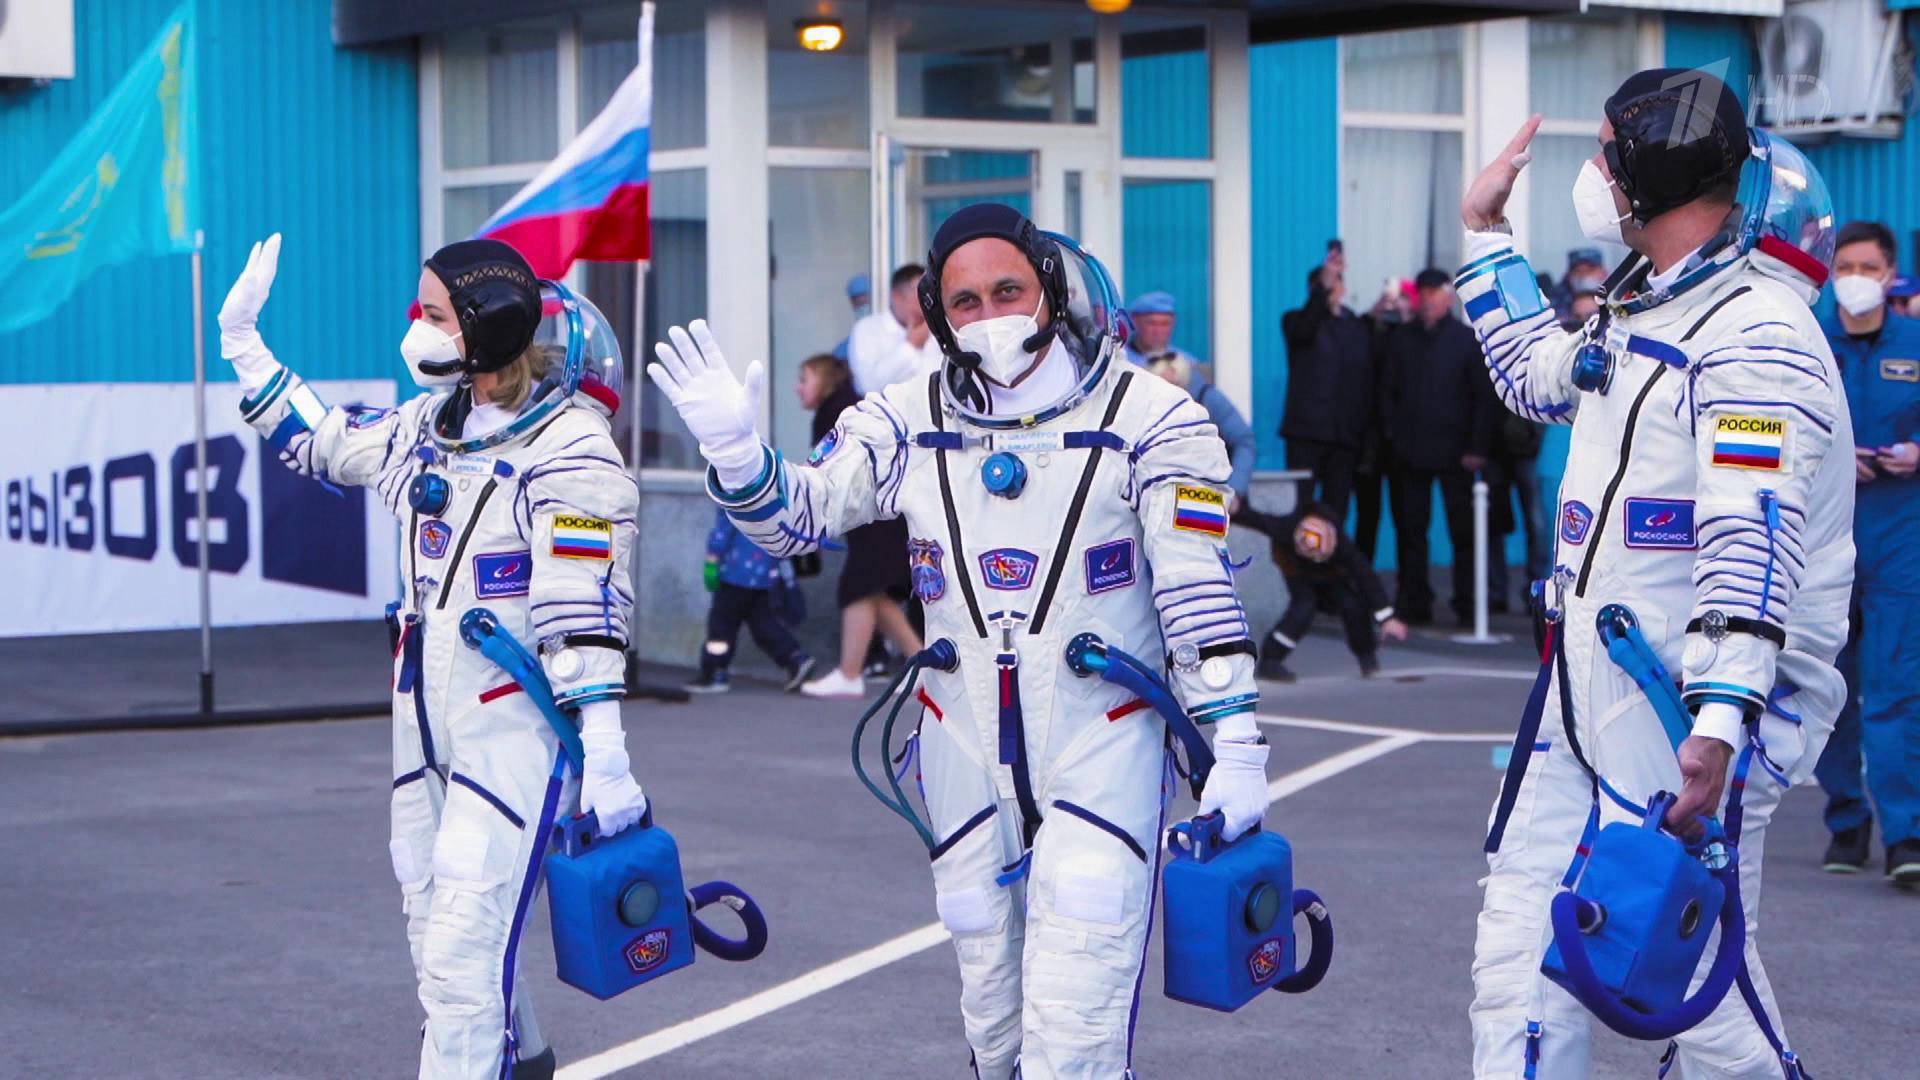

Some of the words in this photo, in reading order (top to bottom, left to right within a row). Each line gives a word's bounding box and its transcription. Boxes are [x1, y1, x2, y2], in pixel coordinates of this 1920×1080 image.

[1717, 418, 1782, 434] РОССИЯ
[8, 434, 250, 575] ВЫЗОВ
[555, 516, 609, 531] РОССИЯ
[1633, 531, 1689, 541] РОСКОСМОС
